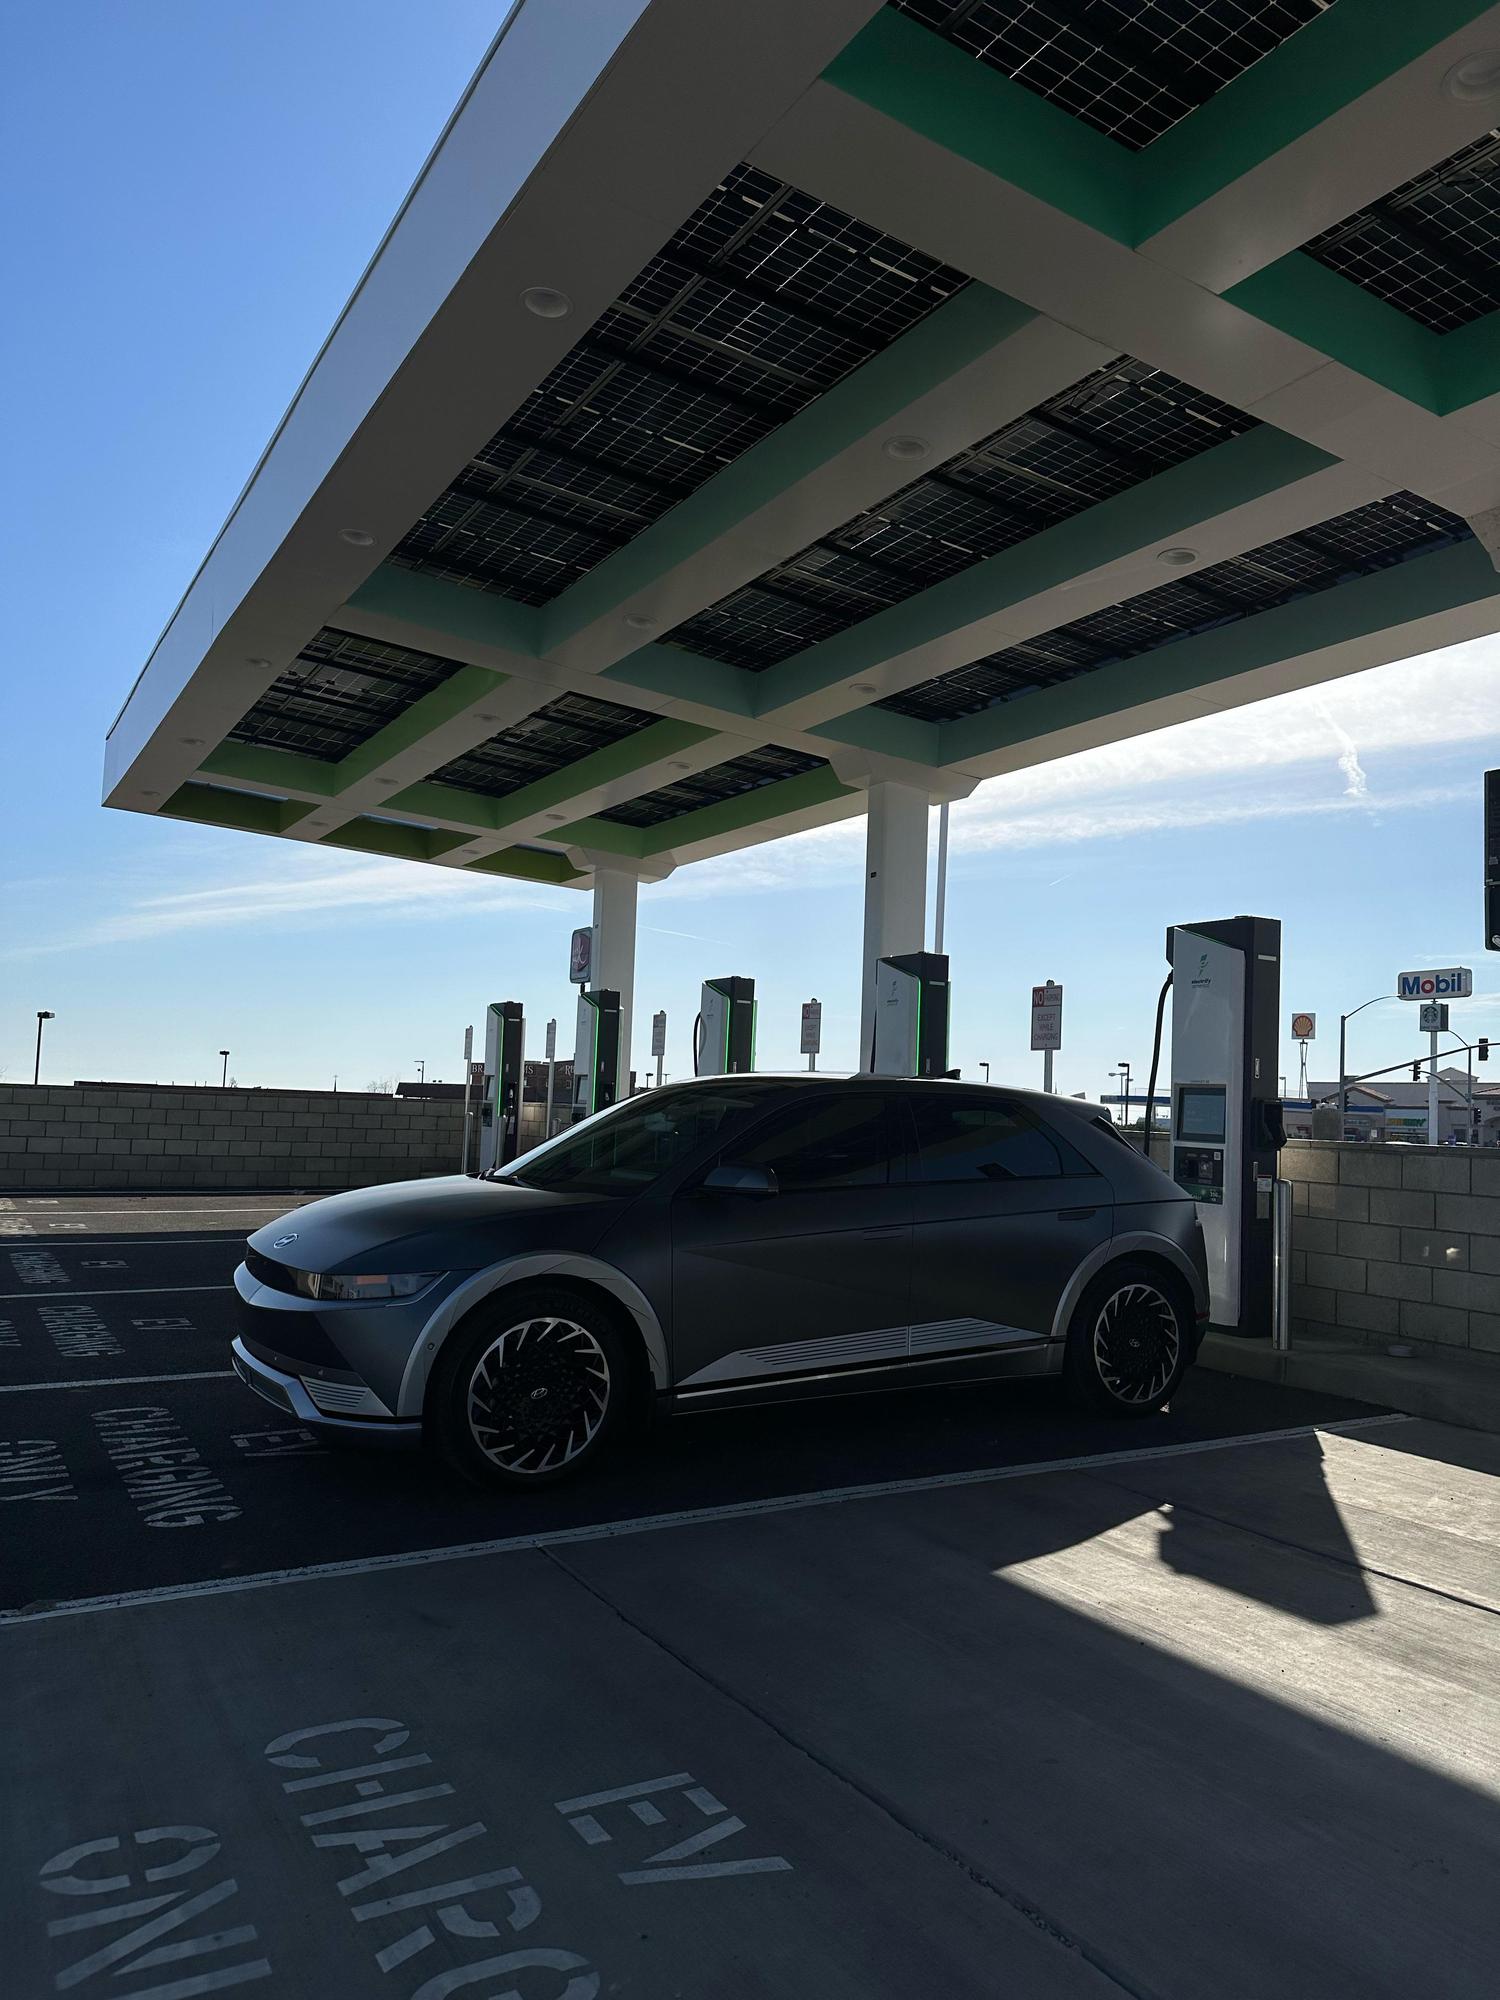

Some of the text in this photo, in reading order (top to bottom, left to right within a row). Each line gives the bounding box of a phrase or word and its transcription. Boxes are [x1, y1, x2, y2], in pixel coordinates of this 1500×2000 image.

[1034, 992, 1044, 1005] NO
[1402, 973, 1462, 995] Mobil
[230, 1427, 331, 1457] EV
[91, 1406, 243, 1528] CHARGING
[554, 1771, 794, 1886] EV
